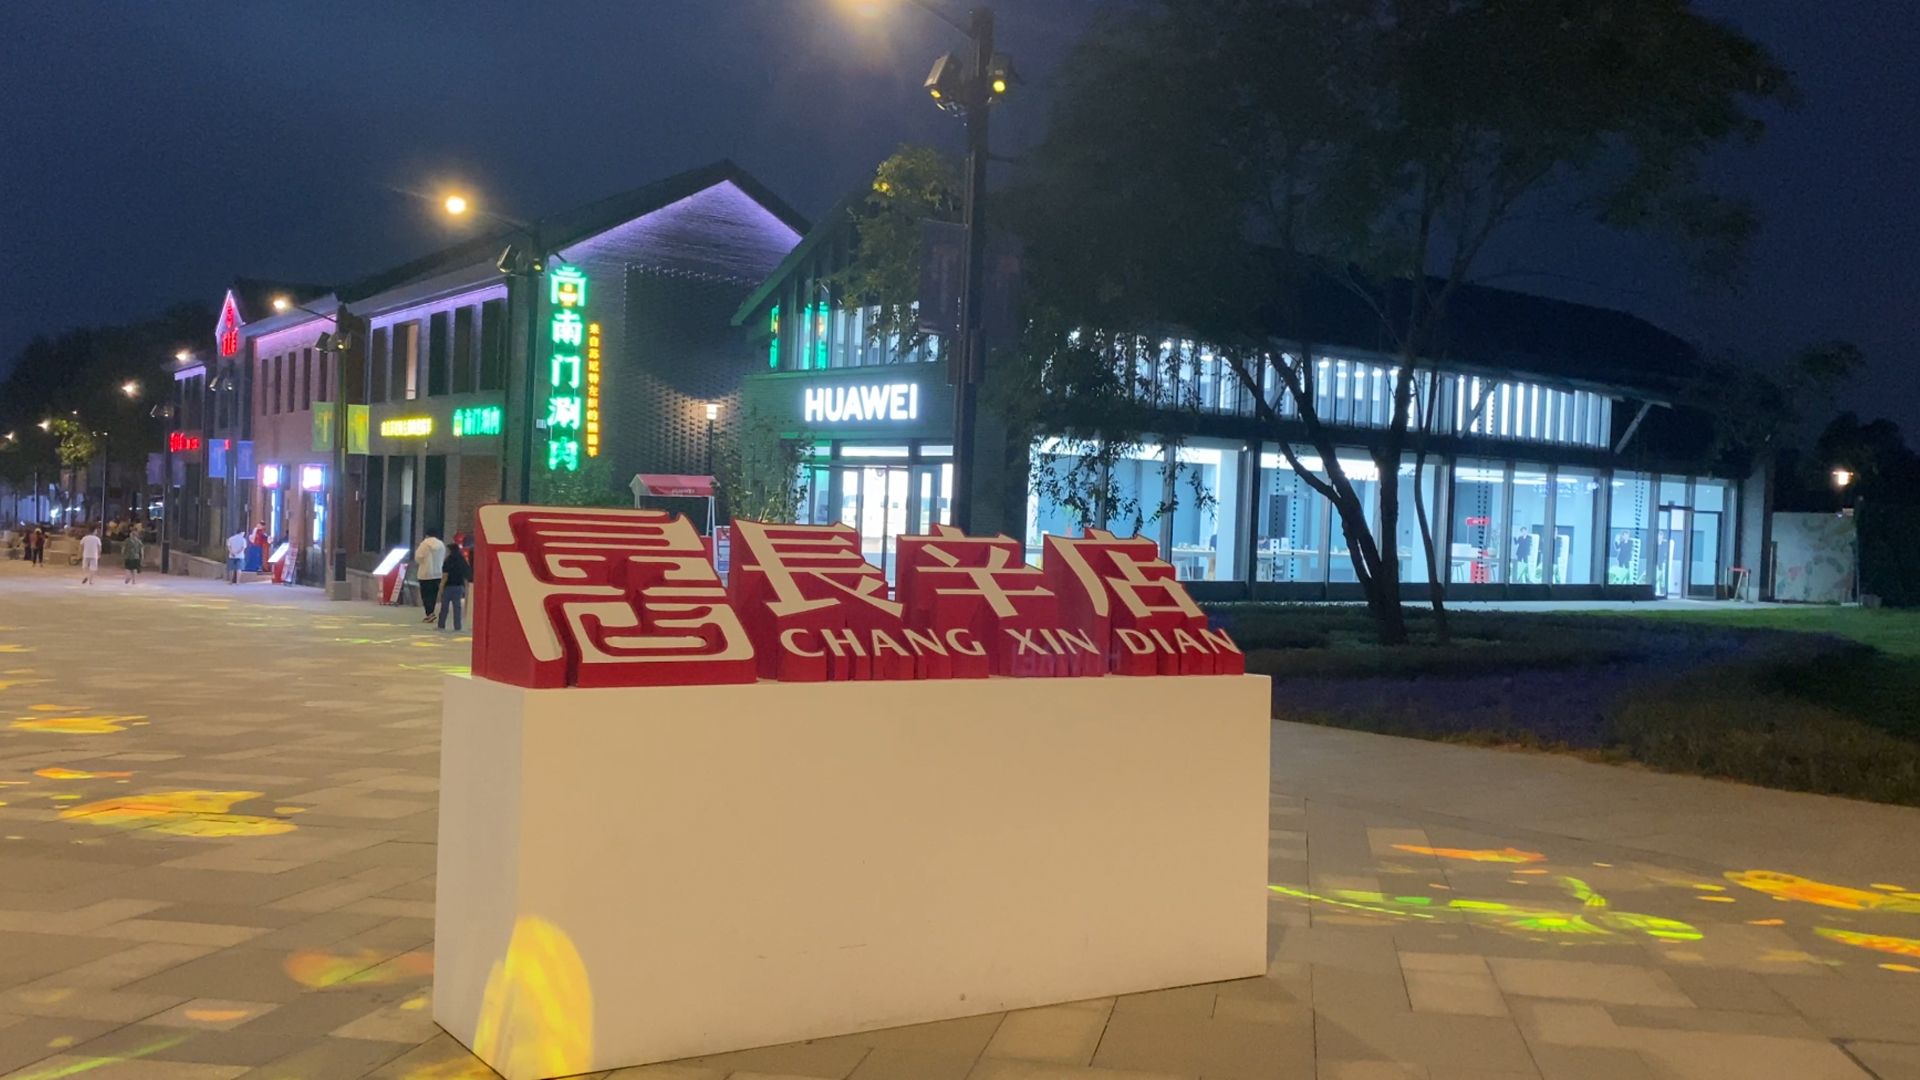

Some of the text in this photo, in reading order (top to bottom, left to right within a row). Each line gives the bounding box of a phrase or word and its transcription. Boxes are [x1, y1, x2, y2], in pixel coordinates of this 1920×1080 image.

[547, 309, 583, 471] 南门涮肉
[804, 383, 918, 422] HUAWEI
[779, 628, 987, 658] CHANG
[1004, 628, 1101, 656] XIN
[1115, 627, 1243, 656] DIAN
